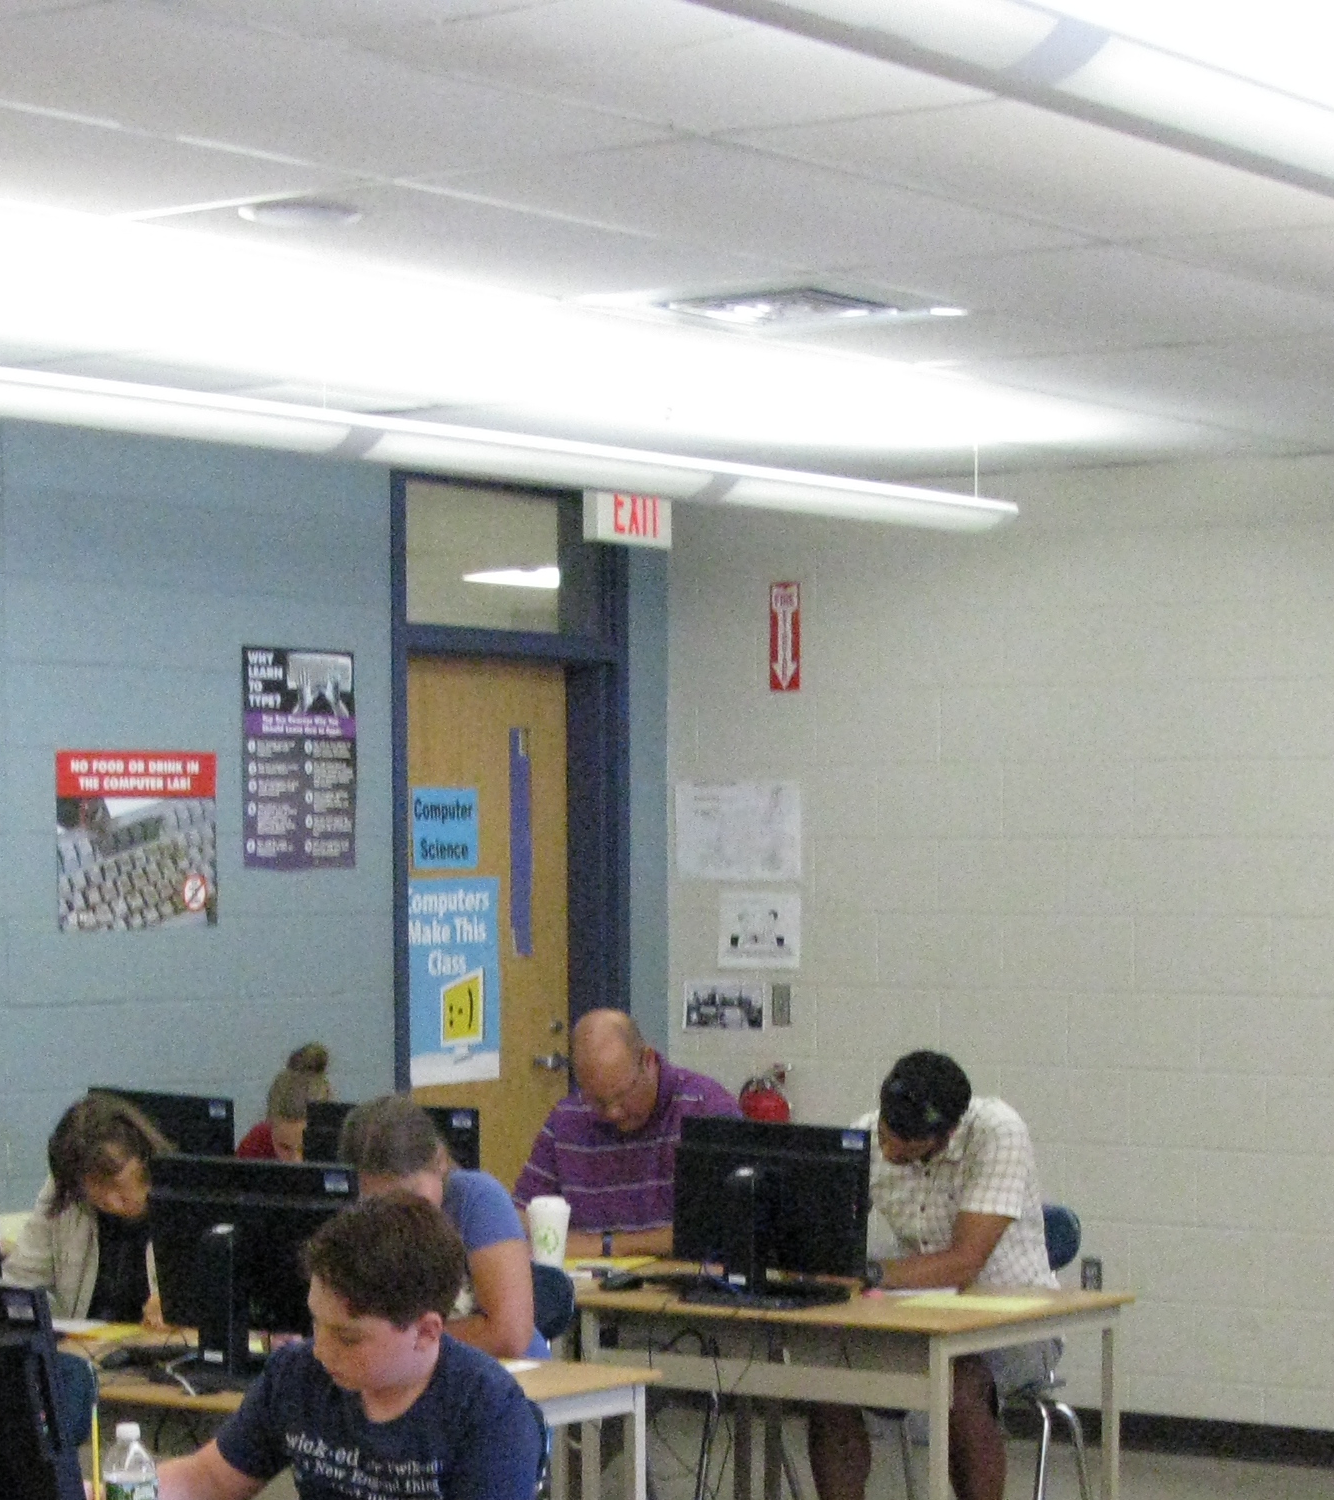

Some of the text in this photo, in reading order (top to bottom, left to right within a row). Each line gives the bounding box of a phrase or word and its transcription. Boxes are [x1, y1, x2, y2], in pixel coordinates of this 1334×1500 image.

[613, 492, 658, 538] EXIT
[248, 651, 274, 665] WHY
[248, 665, 283, 680] LEARN
[249, 680, 262, 693] TO
[249, 693, 281, 709] TYPE?
[70, 759, 200, 775] NO FOOD OR DRINK IN
[78, 776, 191, 791] THE COMPUTER LAB!
[414, 797, 473, 824] Computer
[420, 838, 469, 861] Science
[409, 916, 487, 945] Make This
[428, 950, 467, 977] Class
